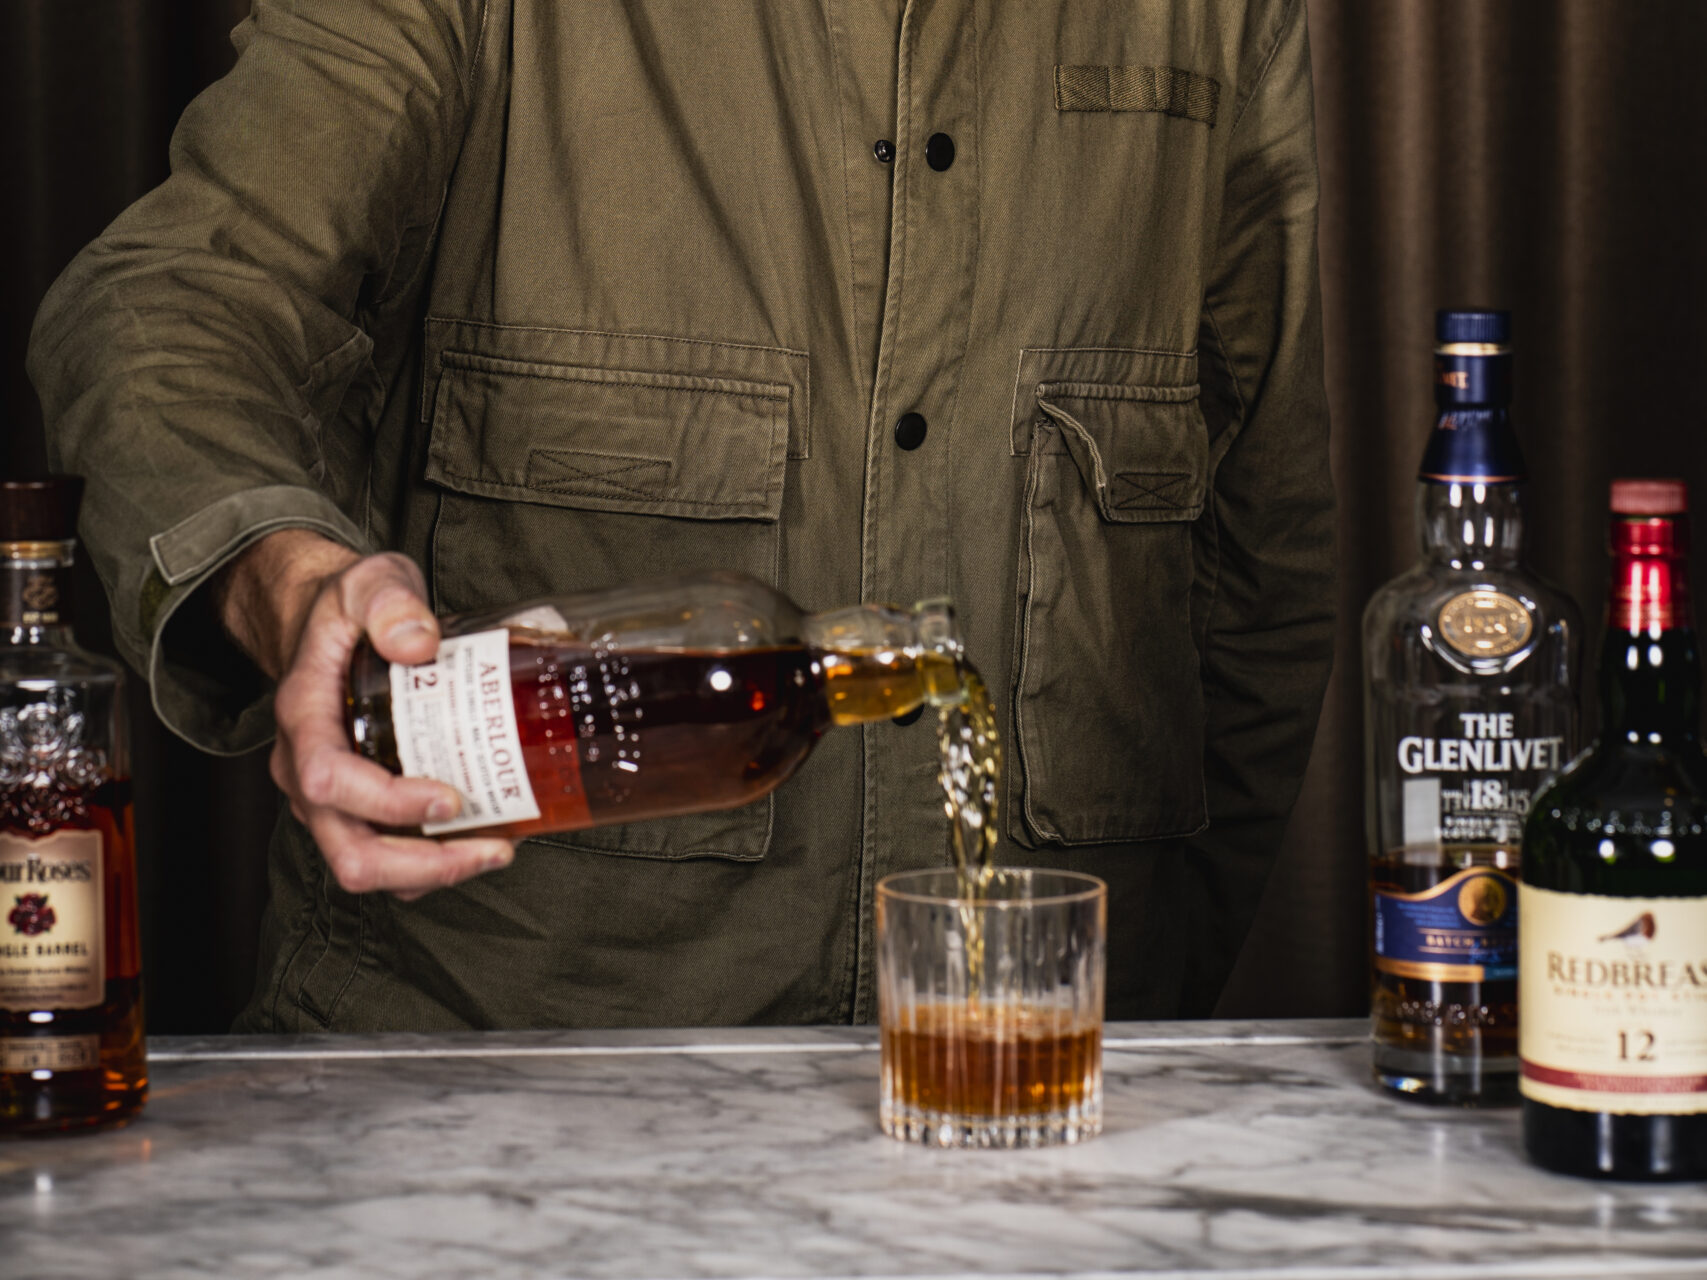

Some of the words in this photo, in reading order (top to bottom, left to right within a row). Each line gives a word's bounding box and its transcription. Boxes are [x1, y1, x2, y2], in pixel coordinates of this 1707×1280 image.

[479, 661, 522, 800] ABERLOUR
[1459, 712, 1514, 739] THE
[1397, 736, 1564, 774] GLENLIVET
[1469, 778, 1503, 810] 18
[26, 856, 91, 883] Roses
[1617, 1030, 1657, 1062] 12
